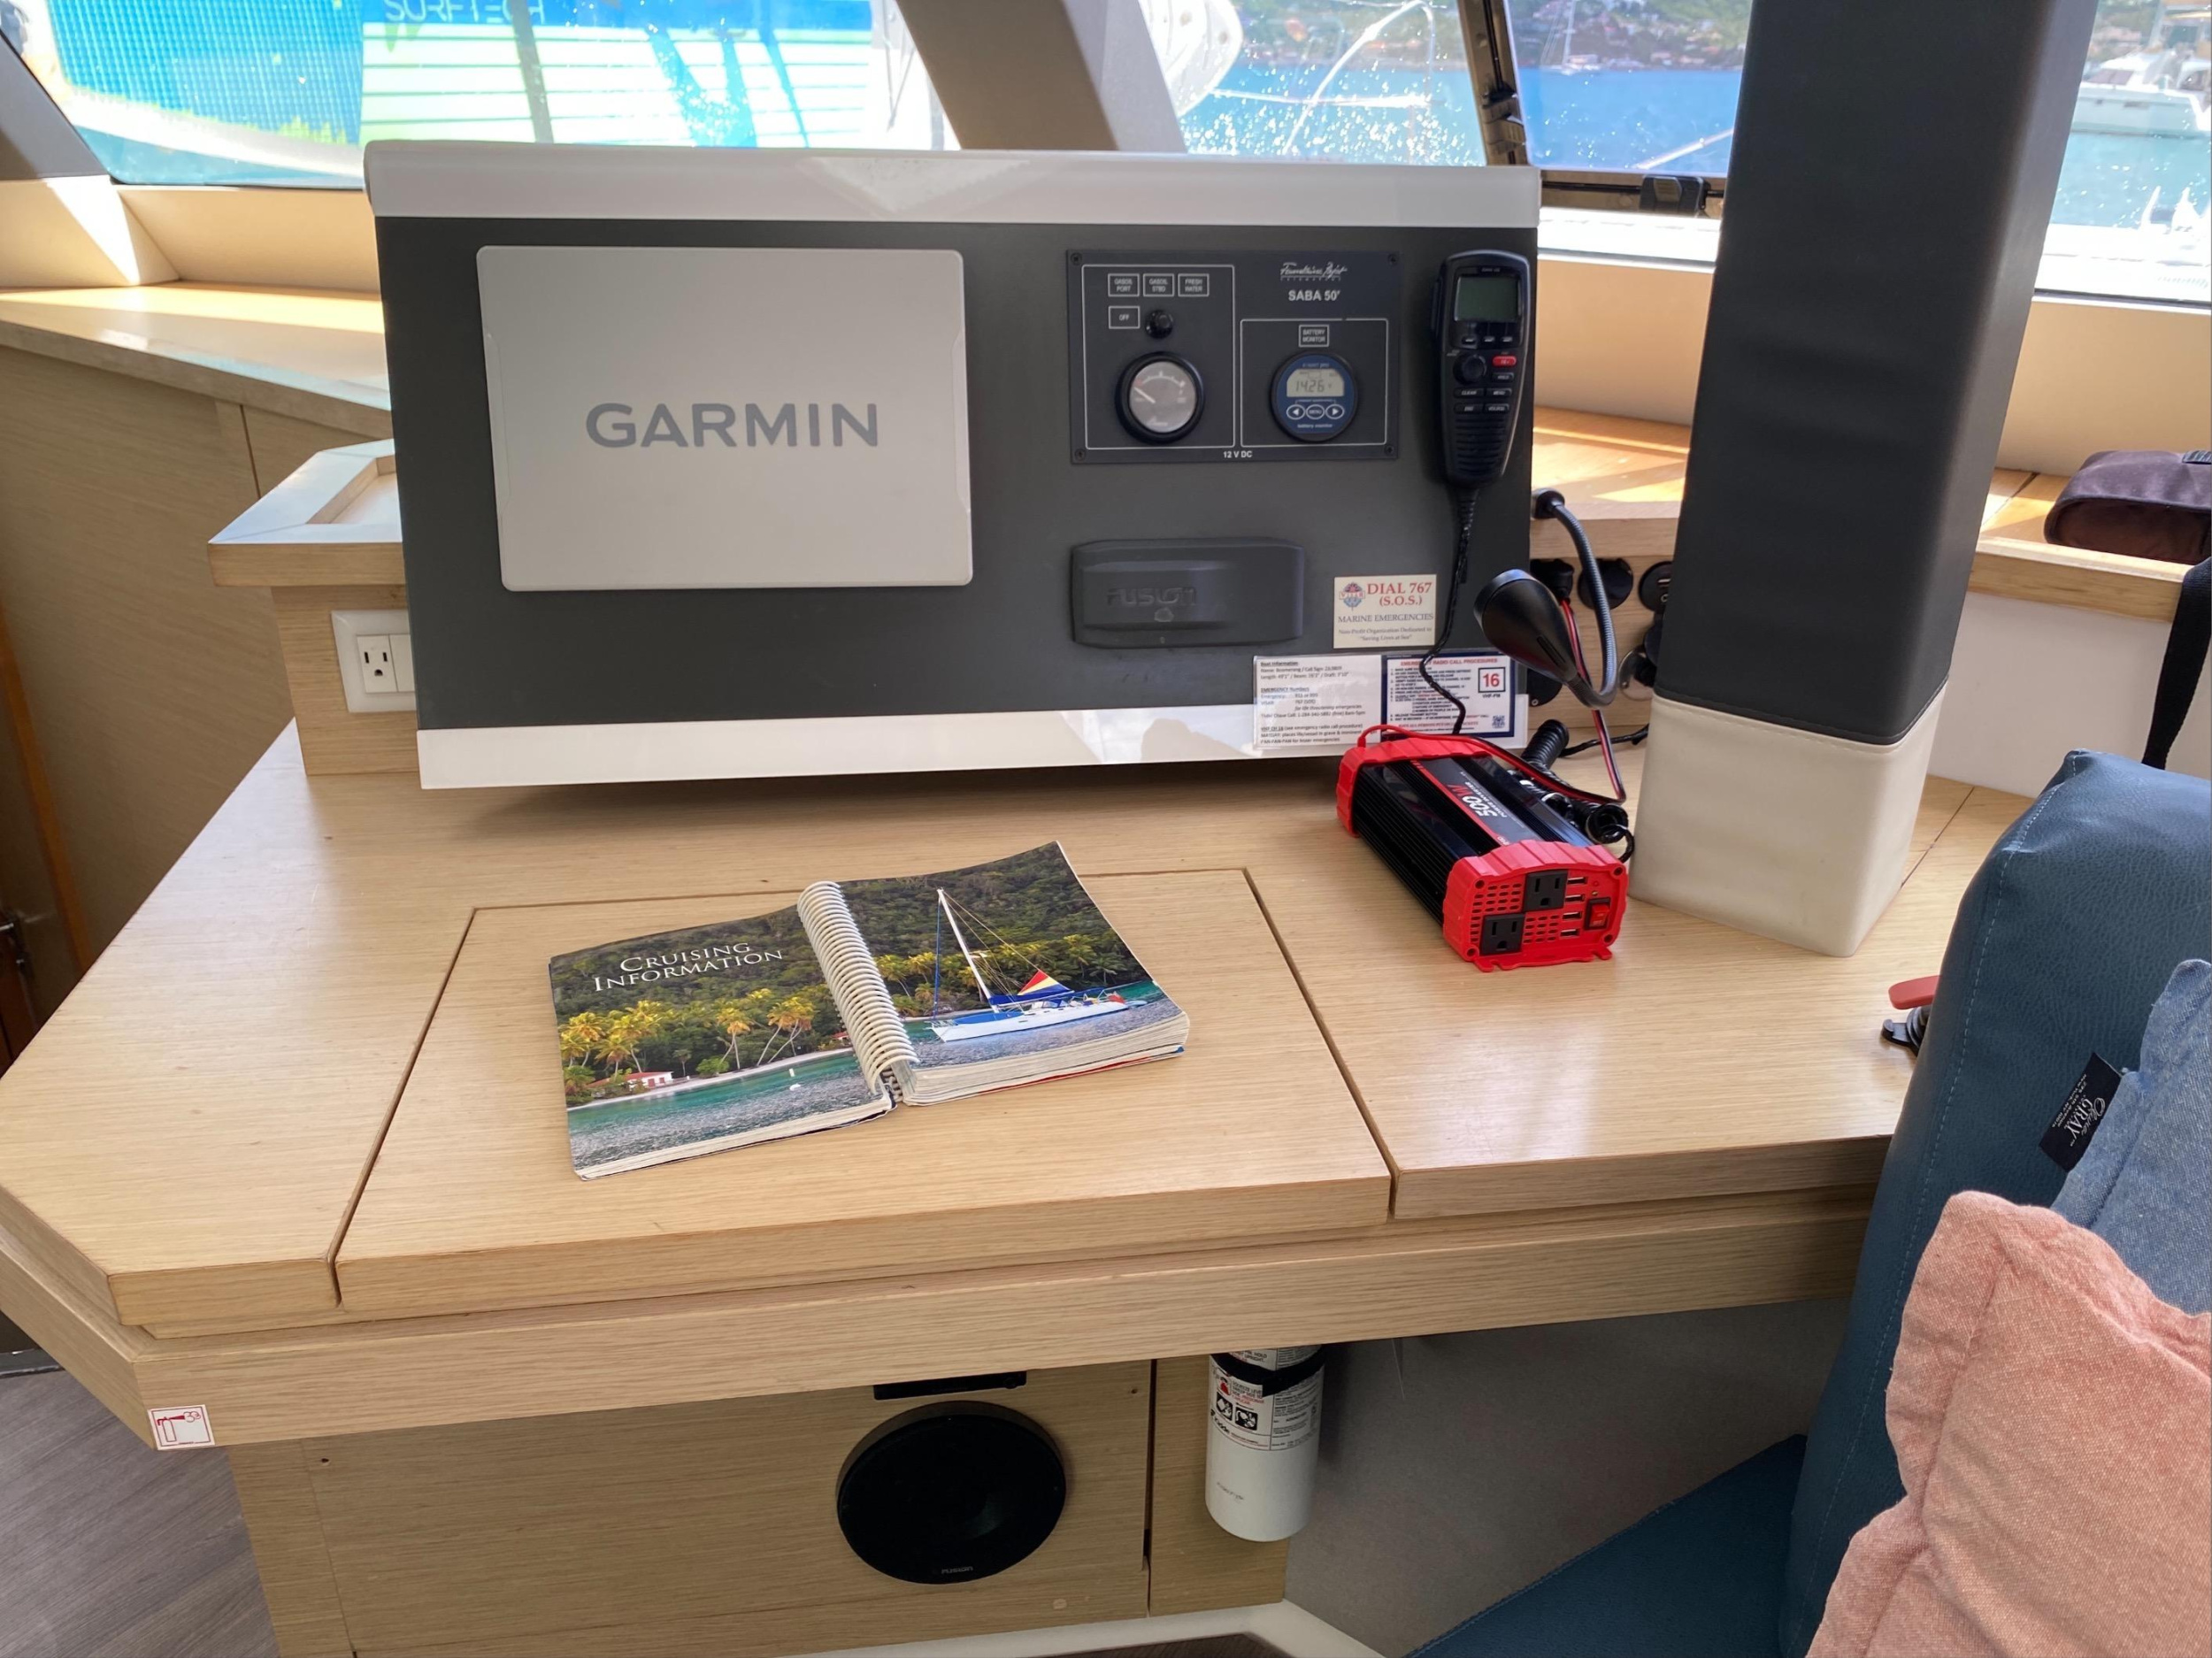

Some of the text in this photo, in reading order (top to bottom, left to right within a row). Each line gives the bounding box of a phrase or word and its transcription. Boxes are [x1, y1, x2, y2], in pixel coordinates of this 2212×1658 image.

[1288, 289, 1322, 302] SABA
[586, 403, 878, 449] GARMIN
[1367, 582, 1432, 595] DIAL 767
[1379, 595, 1423, 607] (S.O.S.)
[1374, 613, 1433, 622] EMERGENCIES
[1482, 672, 1500, 687] 16
[620, 942, 750, 971] CRUISING
[595, 950, 783, 992] INFORMATION
